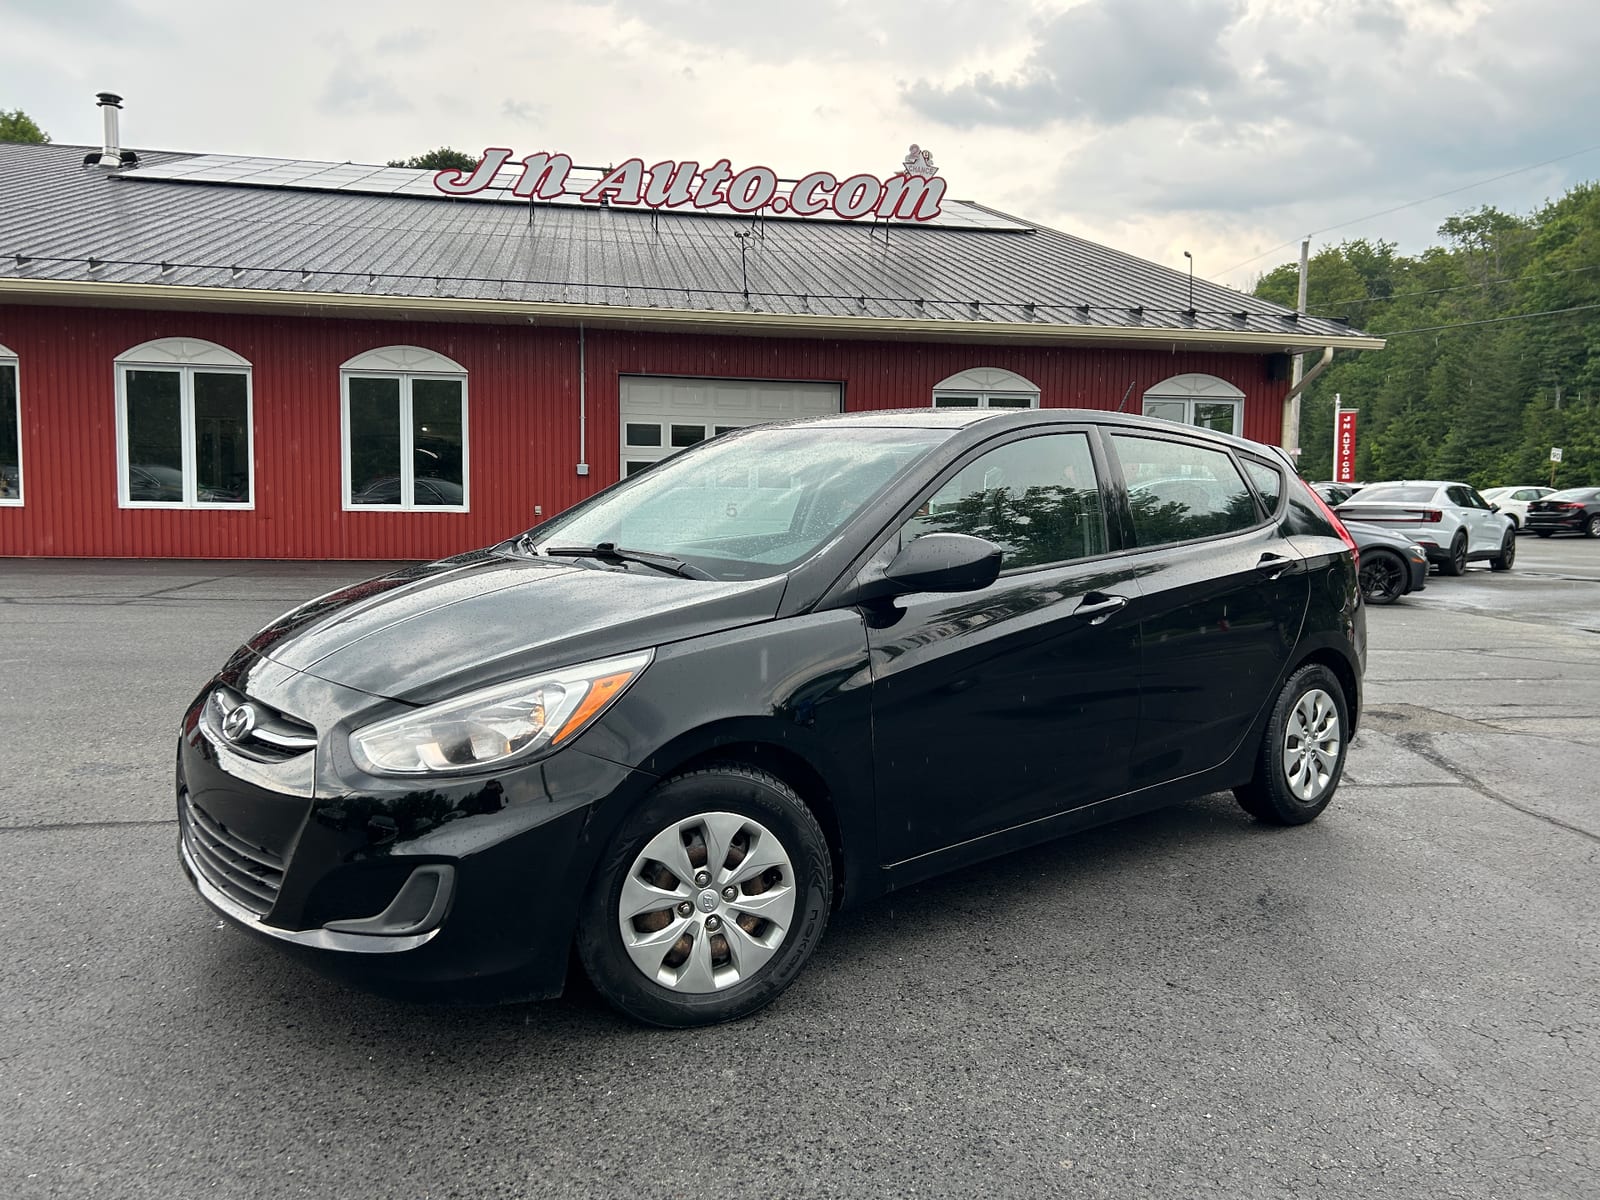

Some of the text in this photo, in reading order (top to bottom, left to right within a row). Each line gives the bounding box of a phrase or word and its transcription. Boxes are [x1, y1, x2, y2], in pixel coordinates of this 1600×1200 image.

[908, 165, 934, 175] CHANCE
[582, 158, 948, 222] Auto.com
[726, 503, 738, 517] 5
